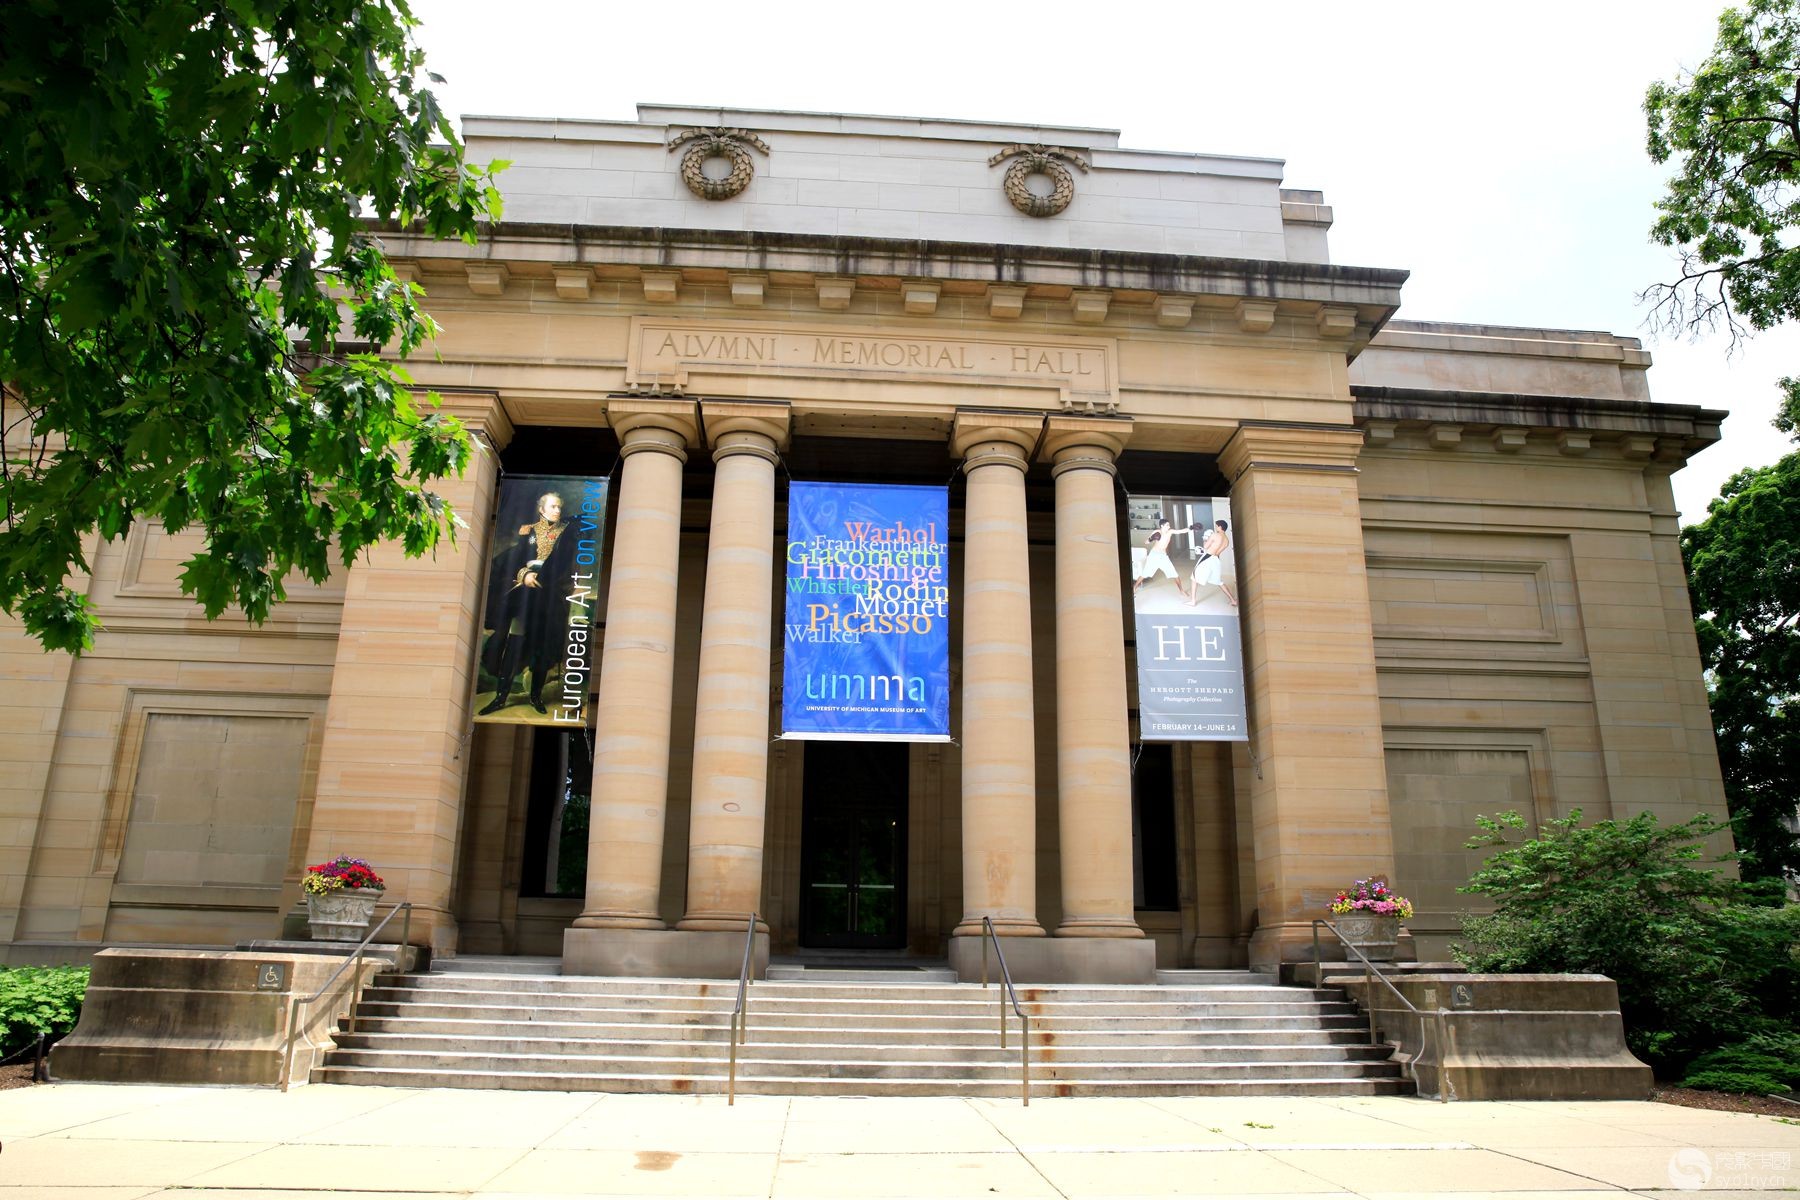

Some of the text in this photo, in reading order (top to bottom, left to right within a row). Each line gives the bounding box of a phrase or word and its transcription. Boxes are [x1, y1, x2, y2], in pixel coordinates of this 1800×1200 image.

[656, 332, 1092, 376] ALVMNI MEMORIAL HALL
[815, 535, 947, 554] Frankenthaler
[845, 521, 936, 544] Warhol
[787, 541, 942, 568] Giacometti
[787, 577, 870, 595] Whistler
[801, 556, 942, 589] Hiroshige
[554, 480, 602, 722] European Art on view
[865, 578, 949, 602] Rodin
[855, 592, 947, 618] Monet
[806, 603, 932, 635] Picasso
[785, 623, 864, 644] Walker
[1152, 625, 1226, 662] HE
[806, 674, 925, 702] umma
